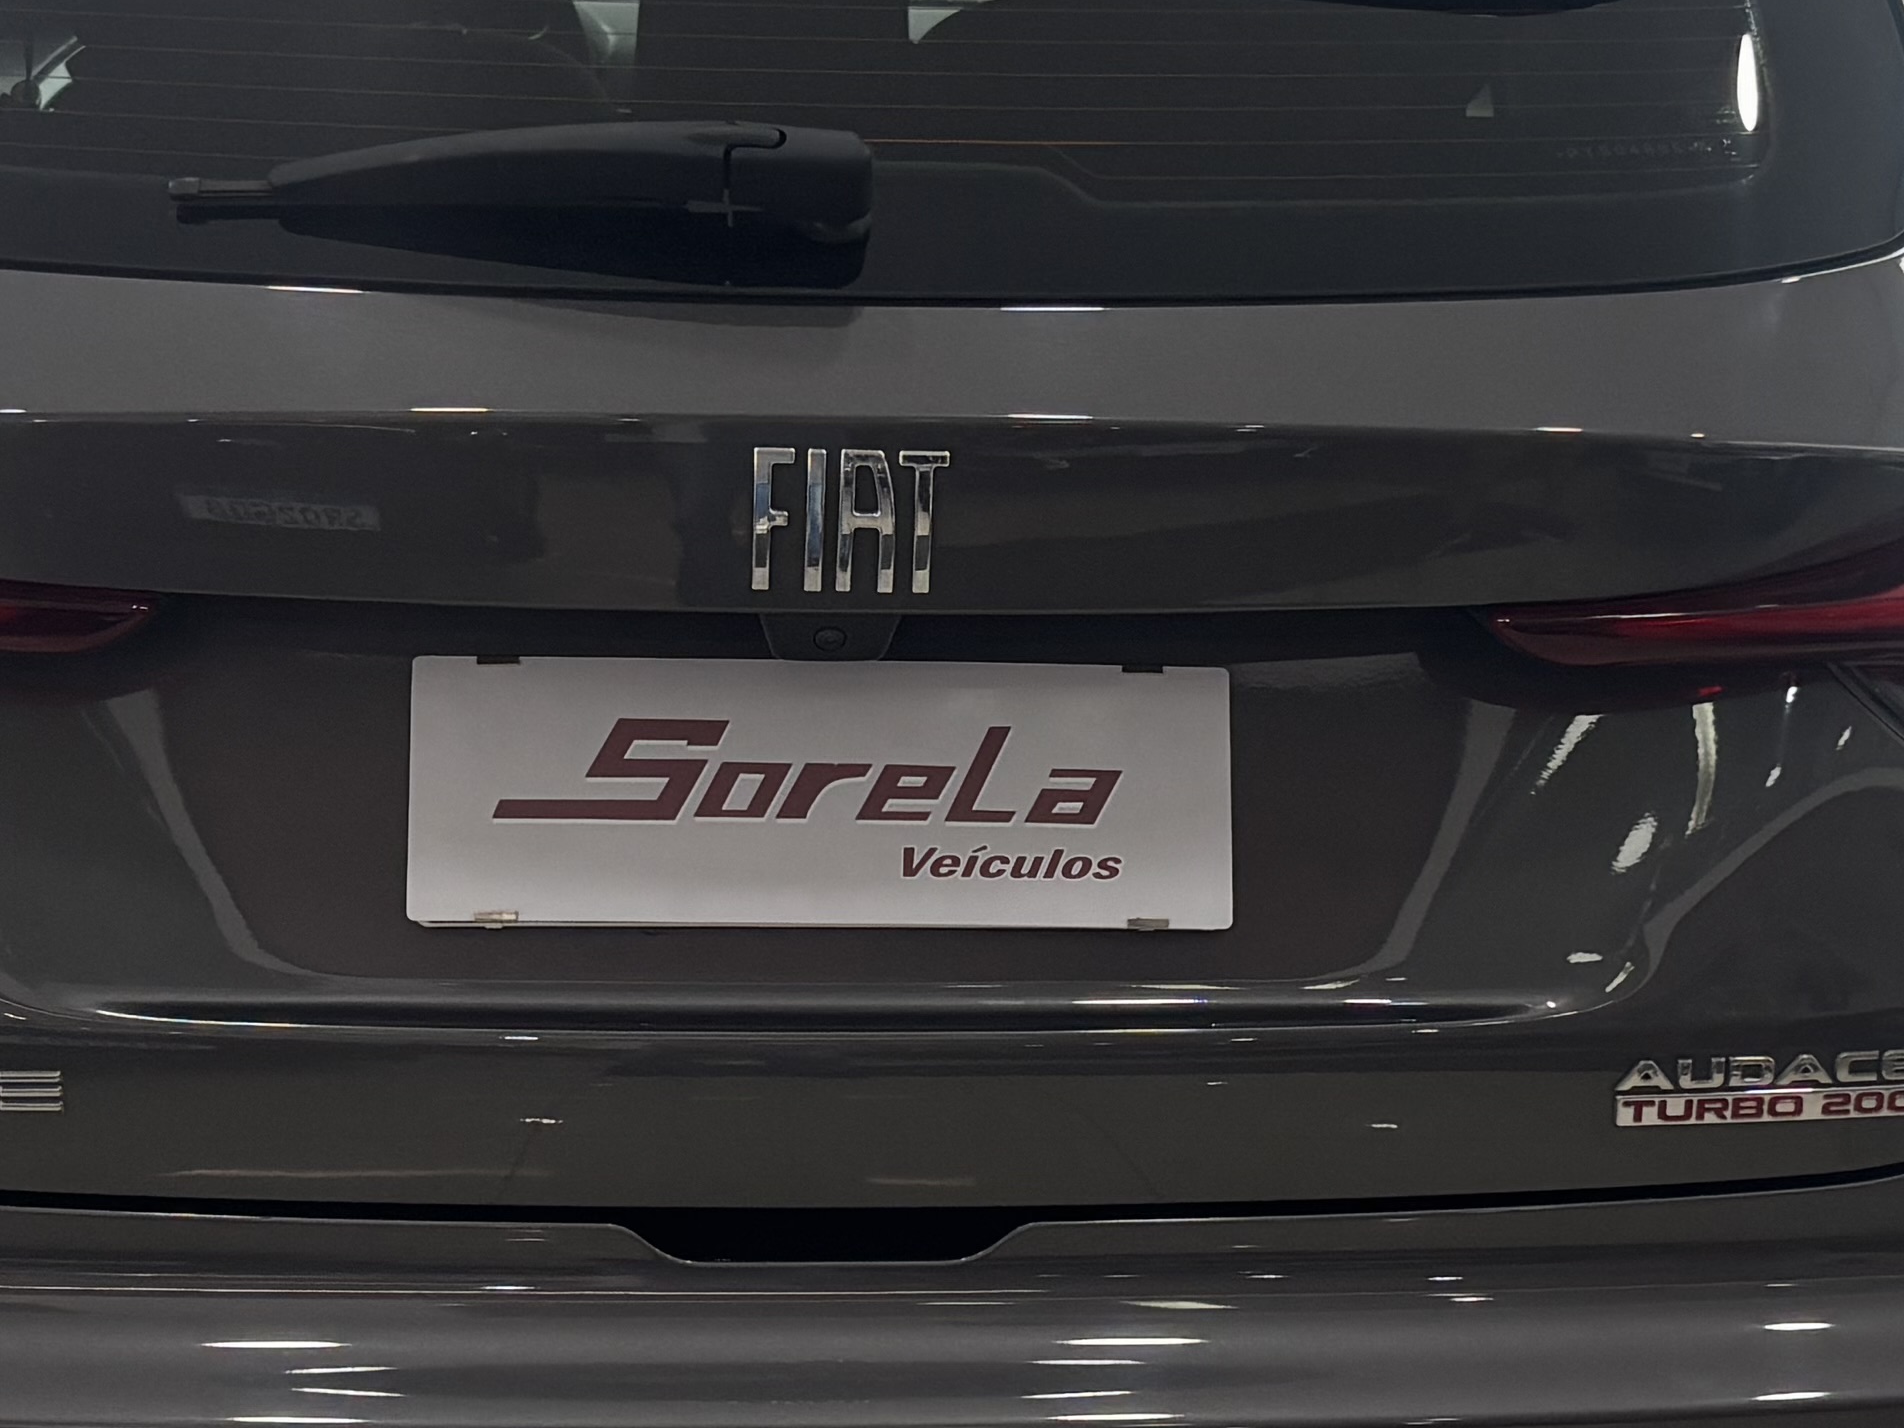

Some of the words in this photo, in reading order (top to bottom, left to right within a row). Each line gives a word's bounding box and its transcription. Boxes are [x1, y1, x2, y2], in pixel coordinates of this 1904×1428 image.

[750, 446, 952, 594] FIAT
[900, 843, 1123, 883] Veículos
[1621, 1093, 1804, 1123] TURBO
